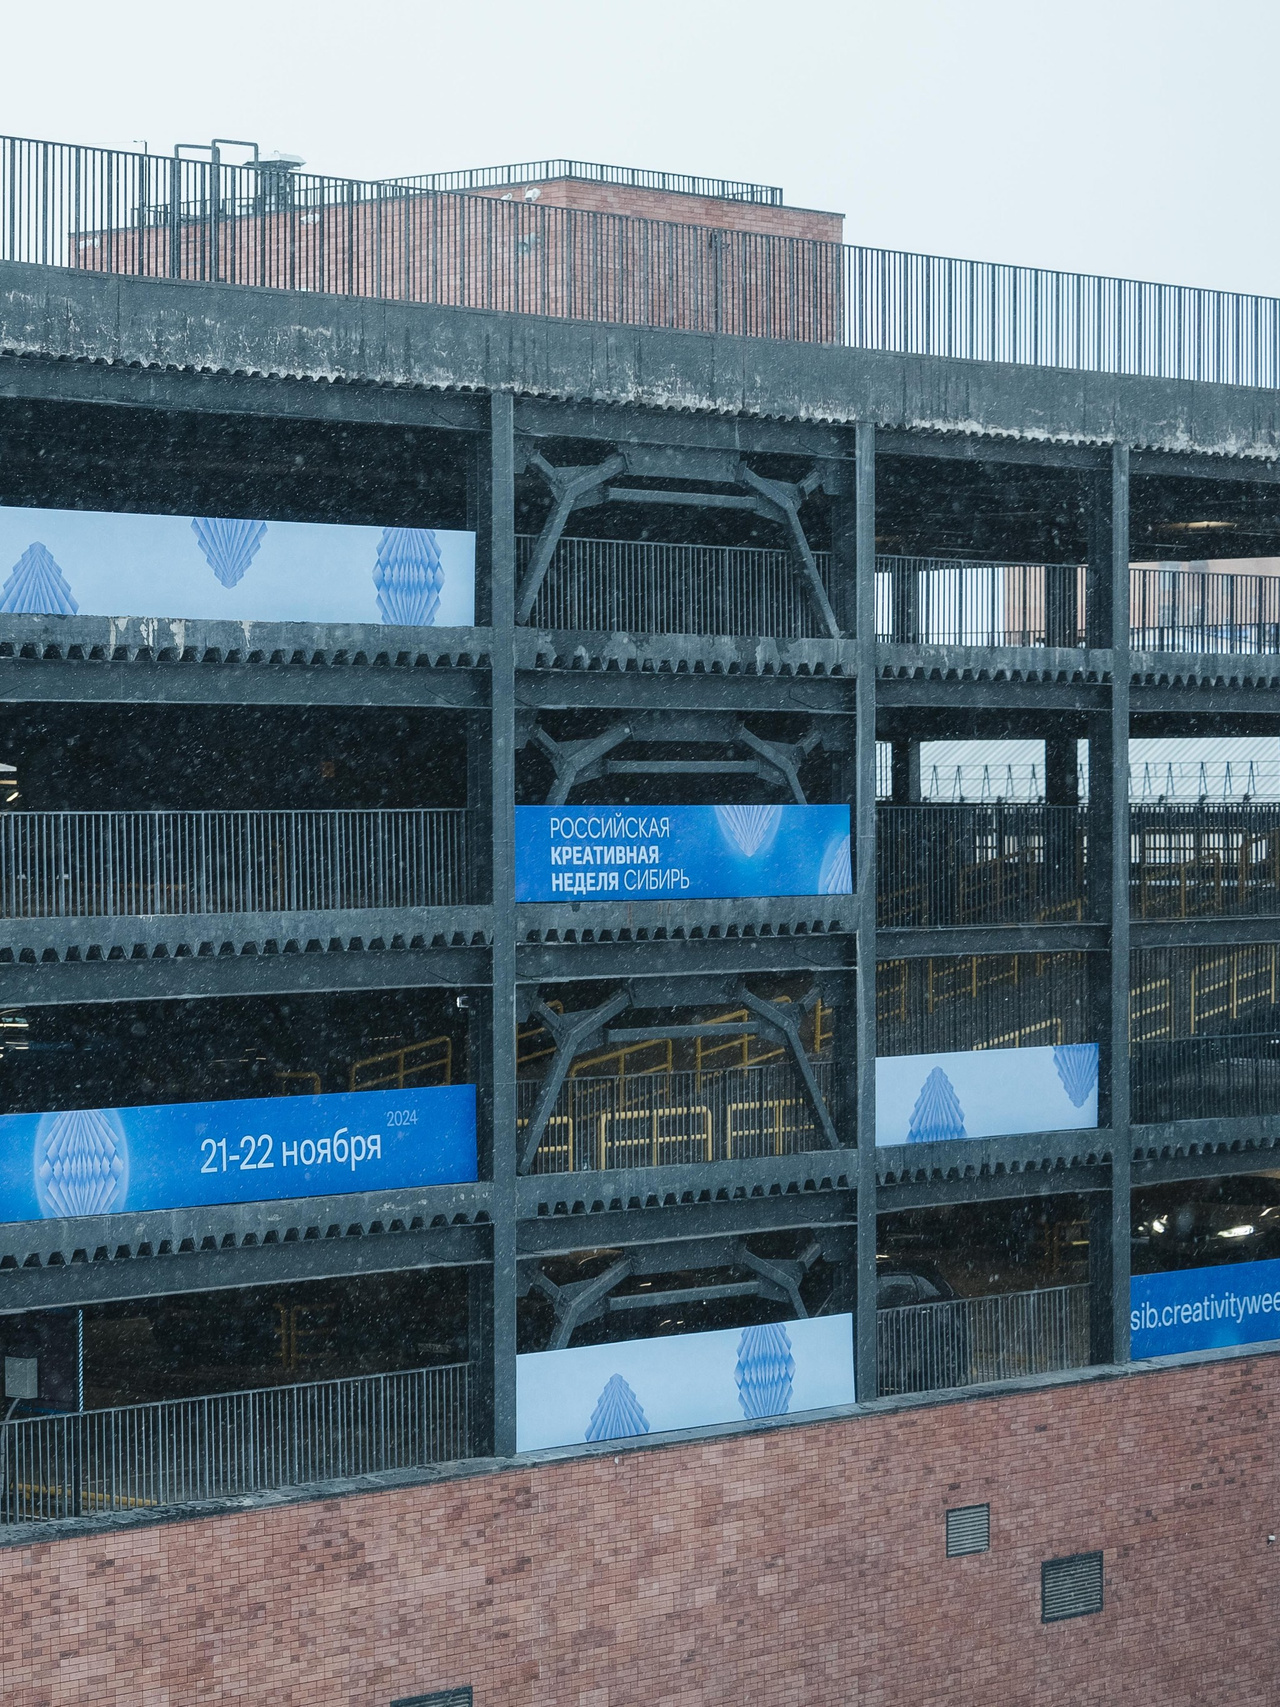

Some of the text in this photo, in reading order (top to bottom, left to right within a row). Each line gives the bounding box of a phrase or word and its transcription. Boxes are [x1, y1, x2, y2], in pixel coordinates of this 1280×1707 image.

[550, 813, 670, 839] РОССИЙСКАЯ
[551, 845, 659, 865] КРЕАТИВНАЯ
[551, 869, 690, 894] НЕДЕЛЯ СИБИРЬ
[386, 1109, 418, 1127] 2024
[200, 1127, 381, 1174] 21-22 ноября
